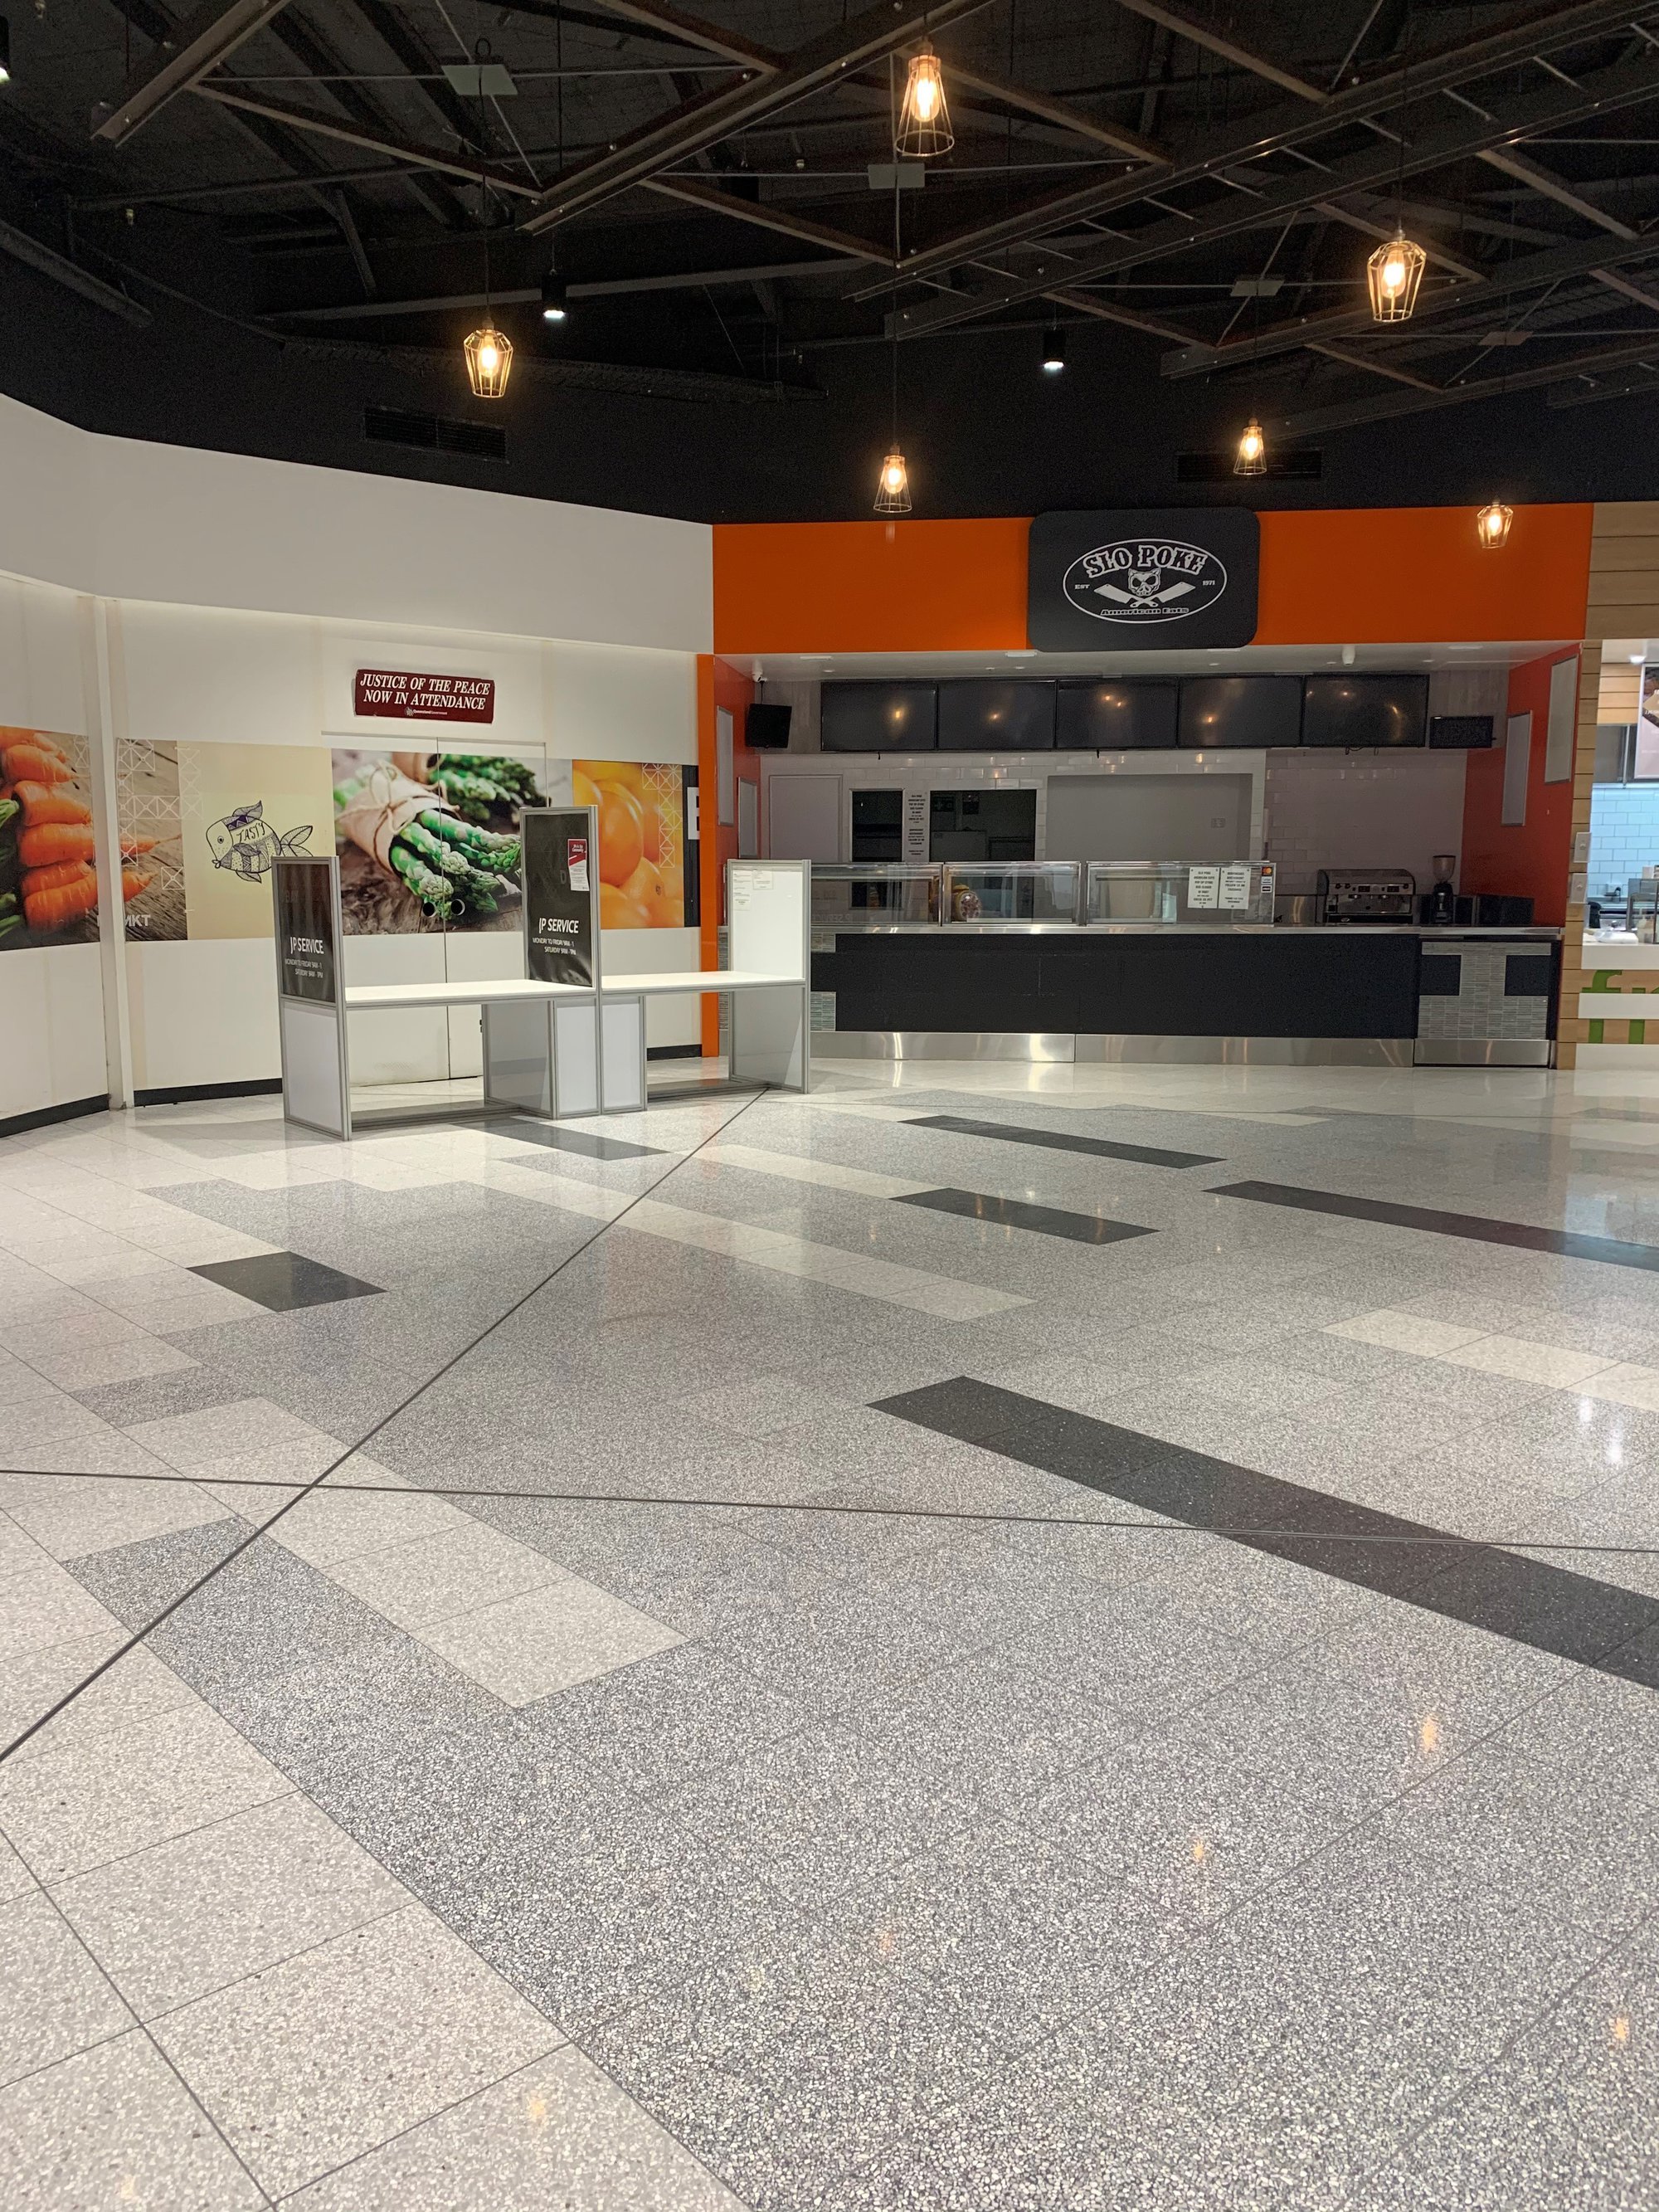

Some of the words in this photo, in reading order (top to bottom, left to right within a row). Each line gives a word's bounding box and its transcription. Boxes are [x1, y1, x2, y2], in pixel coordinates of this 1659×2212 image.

[1082, 548, 1132, 578] SLO
[1137, 544, 1208, 575] POKE
[1101, 608, 1161, 616] American
[360, 673, 408, 689] JUSTICE
[410, 676, 426, 690] OF
[428, 679, 452, 692] THE
[453, 680, 491, 695] PEACE
[363, 689, 393, 704] NOW
[394, 692, 409, 704] IN
[411, 693, 486, 710] ATTENDANCE
[236, 821, 265, 843] TASTY
[539, 918, 547, 933] JP
[547, 918, 579, 933] SERVICE
[290, 937, 297, 954] JP
[297, 938, 324, 954] SERVICE
